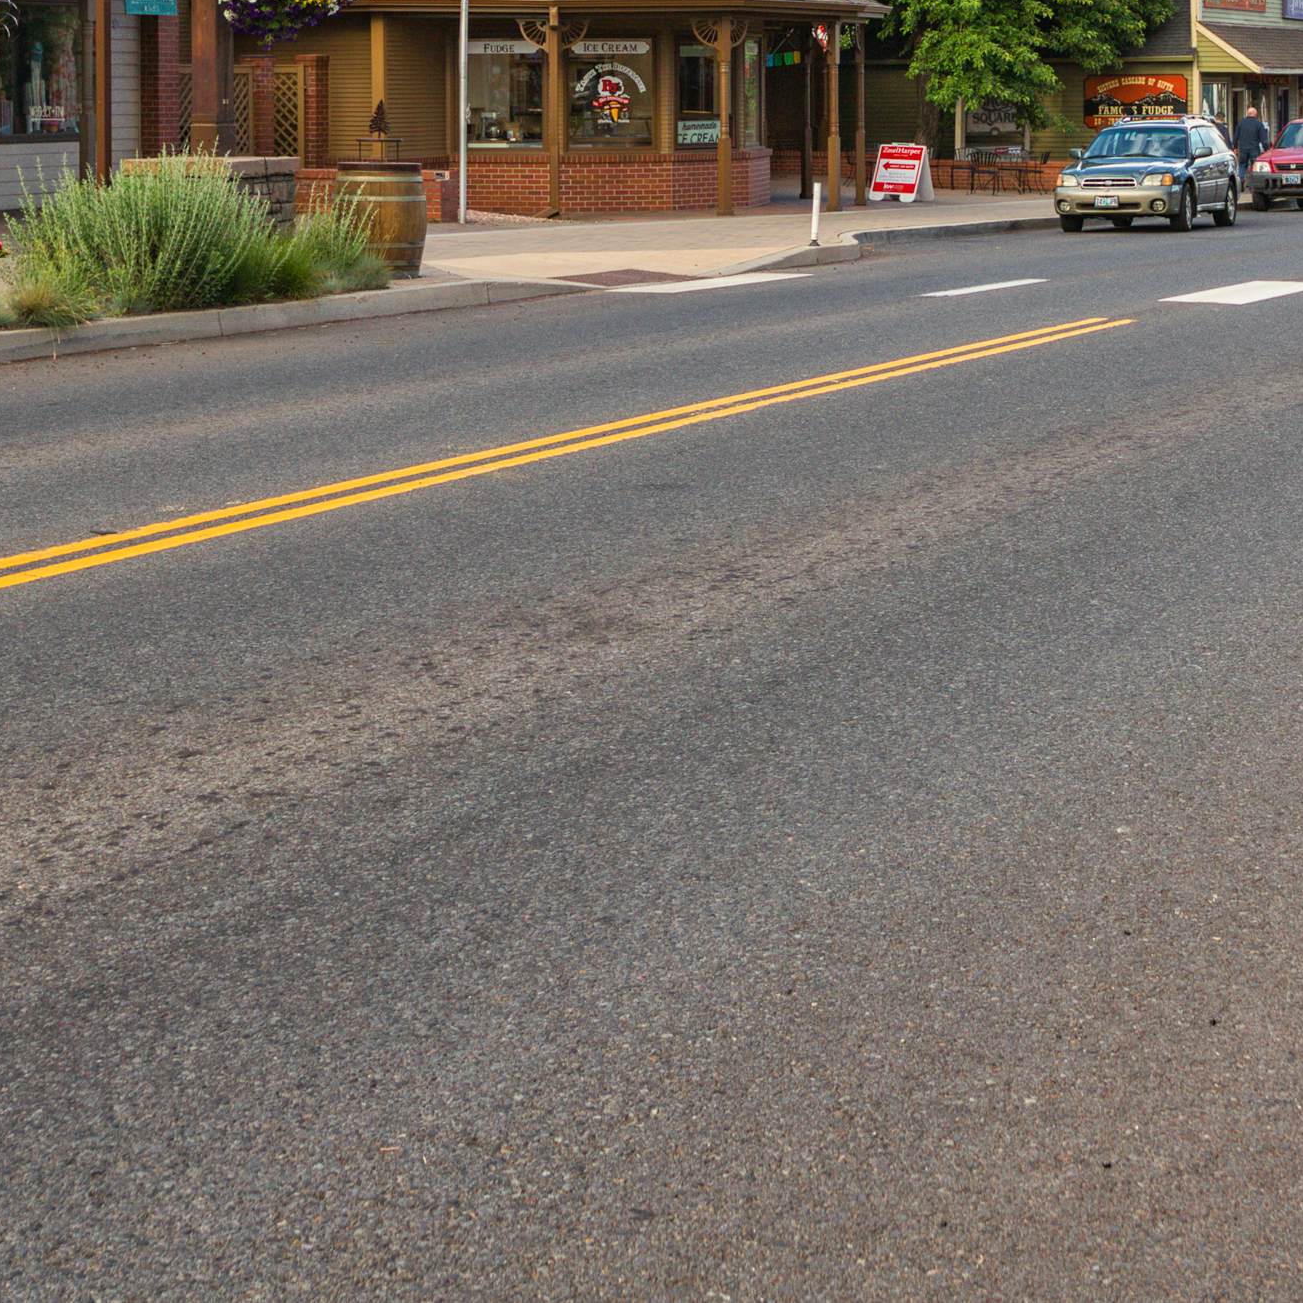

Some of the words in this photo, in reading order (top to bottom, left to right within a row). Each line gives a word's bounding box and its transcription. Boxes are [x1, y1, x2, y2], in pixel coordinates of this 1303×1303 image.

[483, 42, 515, 54] FUDGE
[583, 42, 600, 52] ICE
[601, 41, 638, 53] CREAM
[1142, 105, 1174, 115] FUDGE
